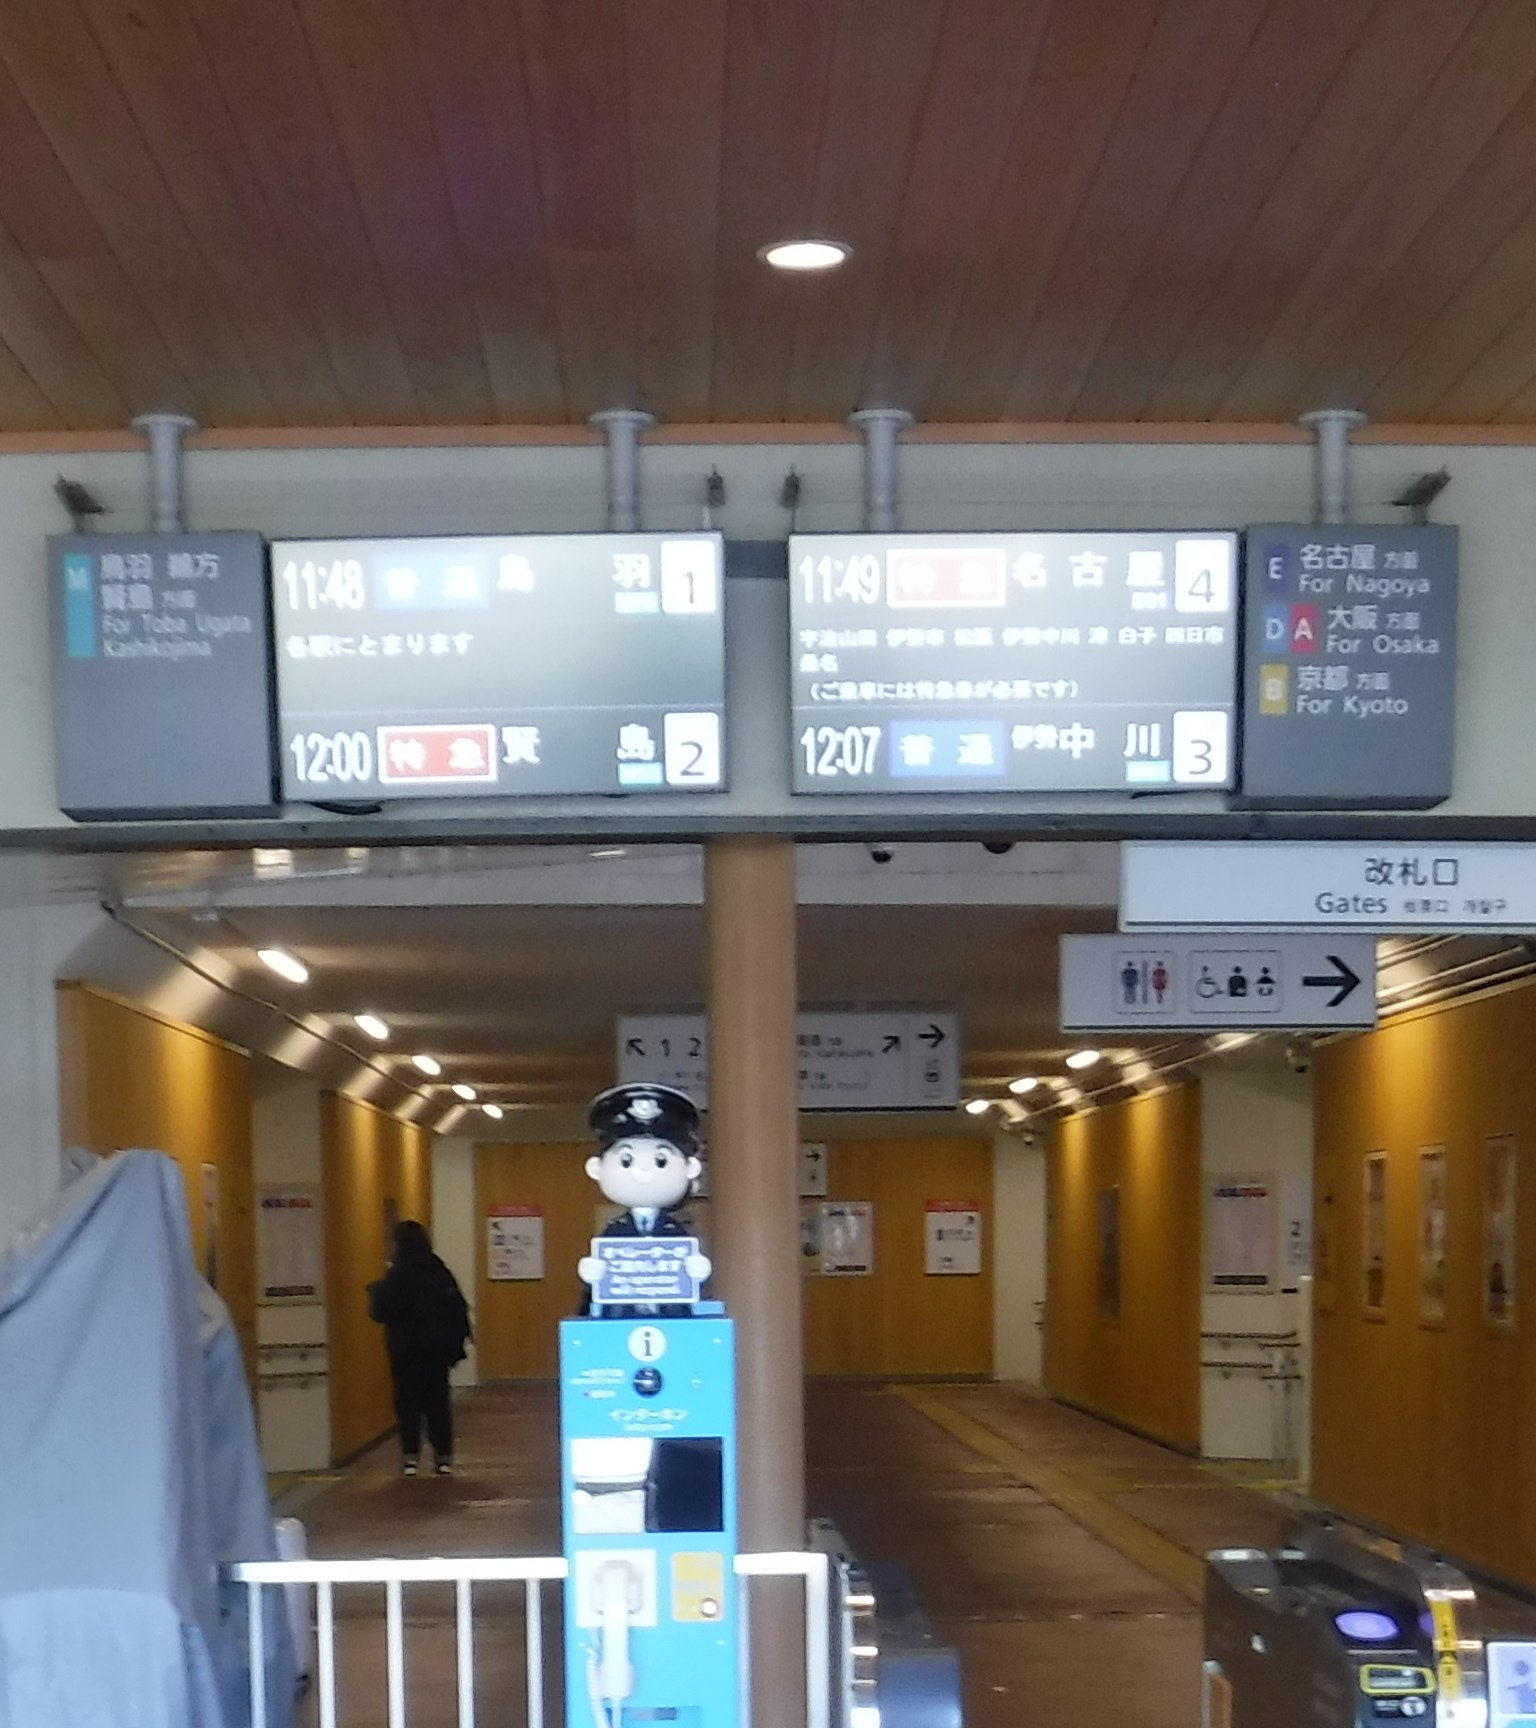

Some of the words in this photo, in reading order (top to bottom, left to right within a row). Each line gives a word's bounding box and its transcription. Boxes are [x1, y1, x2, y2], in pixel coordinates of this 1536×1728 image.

[1268, 556, 1284, 580] E
[1300, 544, 1376, 570] 名古屋
[1384, 551, 1419, 570] 方面
[283, 560, 363, 610] 11:48
[682, 571, 695, 605] 1
[799, 553, 880, 604] 11:49
[1012, 550, 1165, 588] 名古屋
[1188, 569, 1215, 604] 4
[1298, 574, 1334, 593] For
[1346, 573, 1431, 599] Nagoya
[1266, 618, 1285, 641] D
[1294, 617, 1313, 641] A
[1327, 604, 1379, 631] 大阪
[1386, 612, 1420, 630] 方面
[1326, 635, 1362, 655] For
[1372, 634, 1440, 655] Osaka
[1298, 664, 1349, 691] 京都
[1296, 695, 1332, 714] For
[1343, 696, 1408, 719] Kyoto
[290, 732, 372, 781] 12:00
[680, 741, 705, 776] 2
[800, 726, 882, 777] 12:07
[1188, 739, 1213, 776] 3
[1365, 857, 1458, 887] 改札口
[1315, 892, 1388, 914] Gates
[661, 1038, 670, 1058] 1
[688, 1037, 702, 1058] 2
